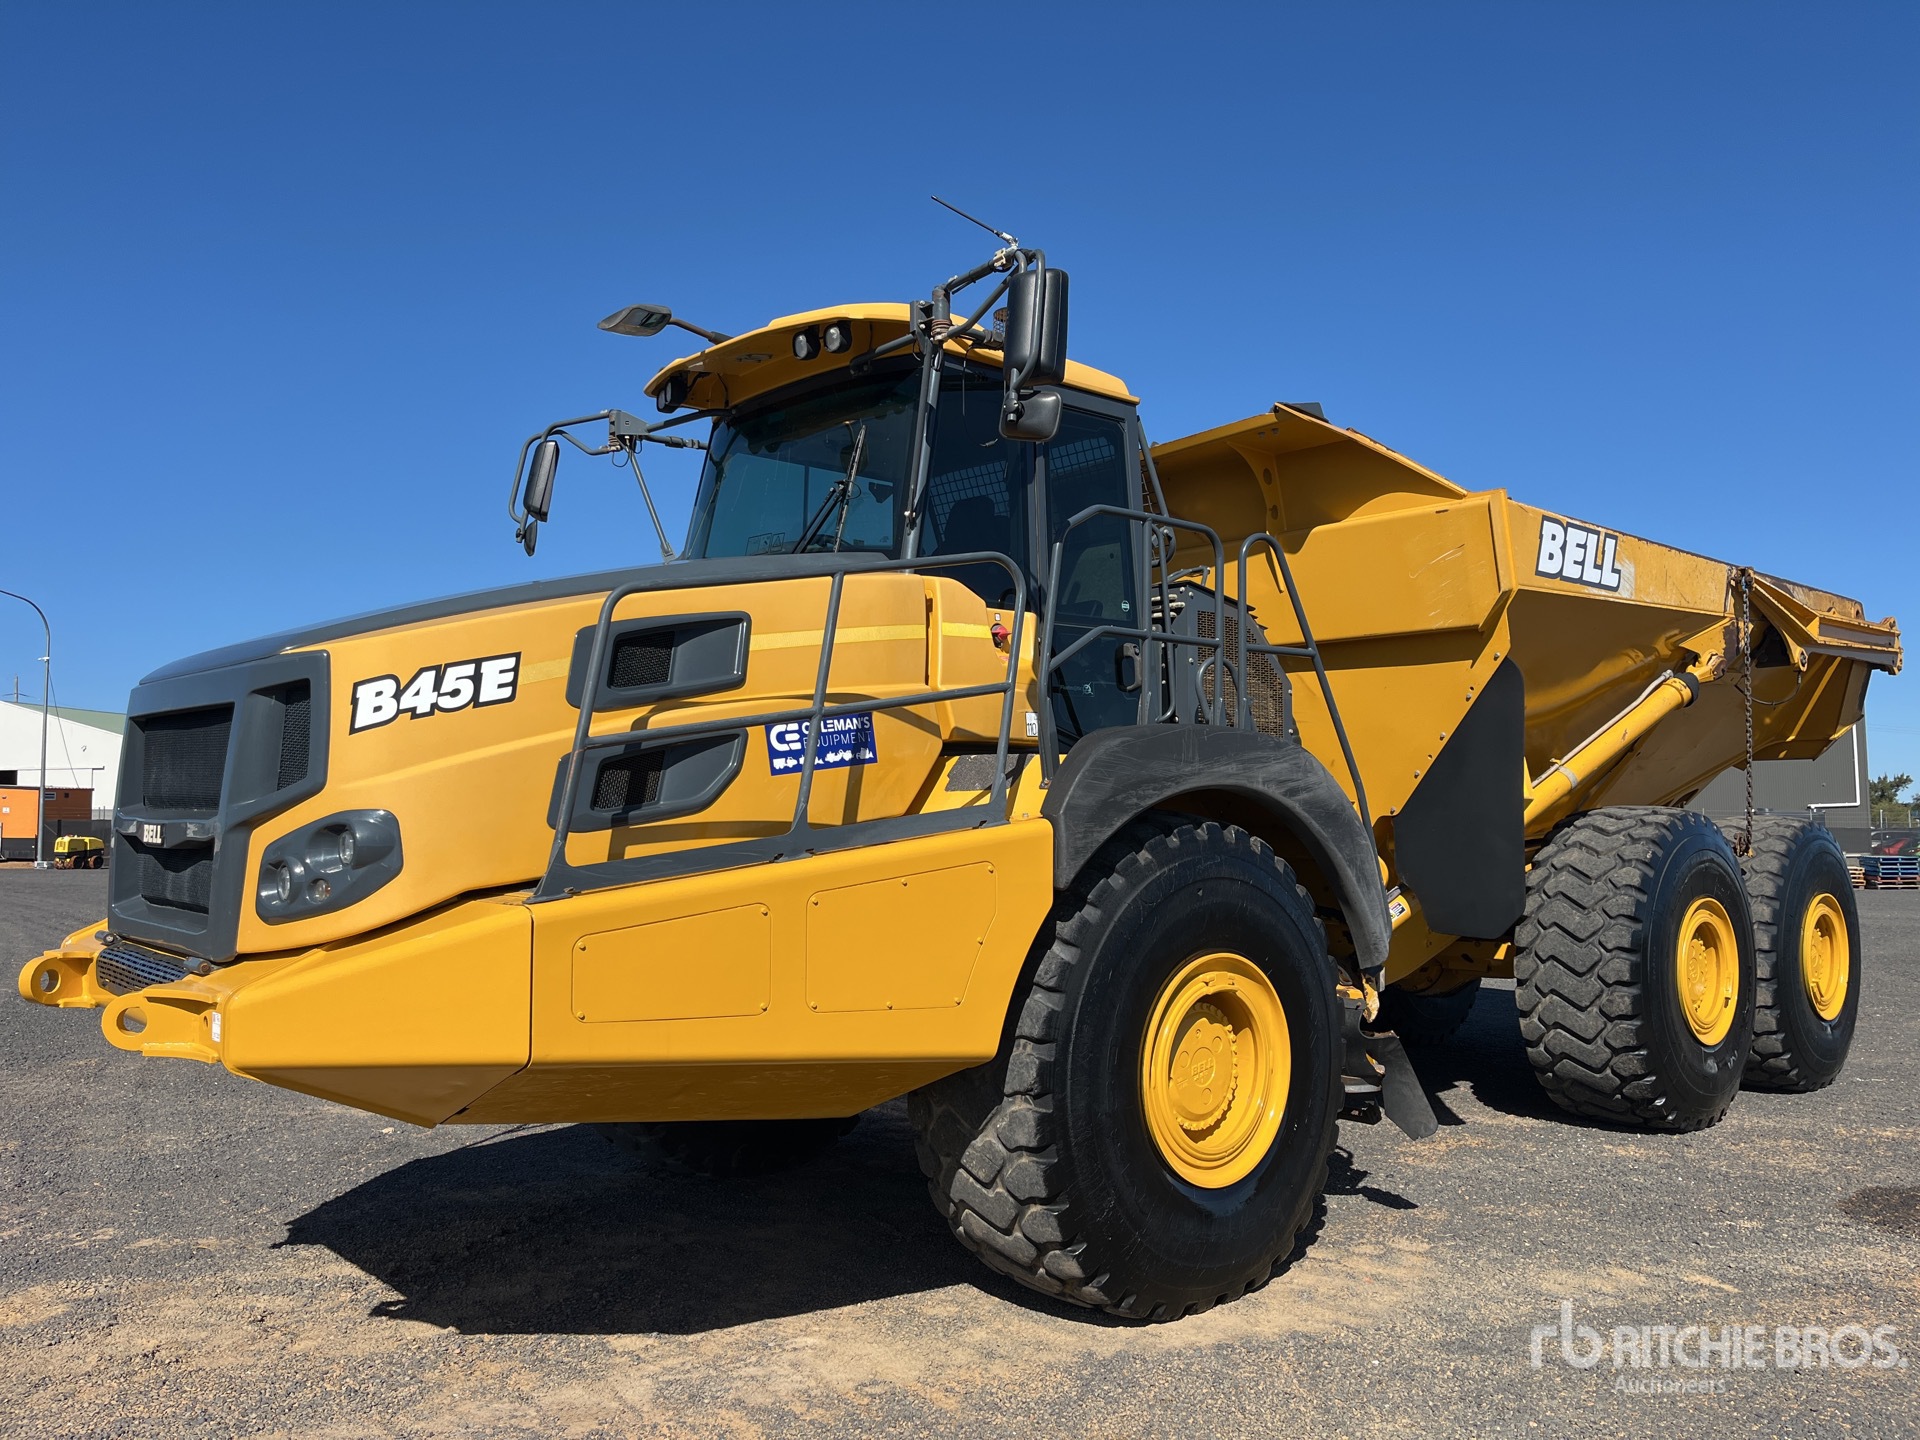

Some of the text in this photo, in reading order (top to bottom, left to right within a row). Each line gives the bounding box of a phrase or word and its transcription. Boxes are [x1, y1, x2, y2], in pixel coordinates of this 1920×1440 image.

[1536, 516, 1621, 591] BELL
[350, 653, 520, 733] B45E
[801, 716, 871, 734] CLEMAN'S
[143, 824, 162, 844] BELL
[1191, 1057, 1214, 1077] BELL
